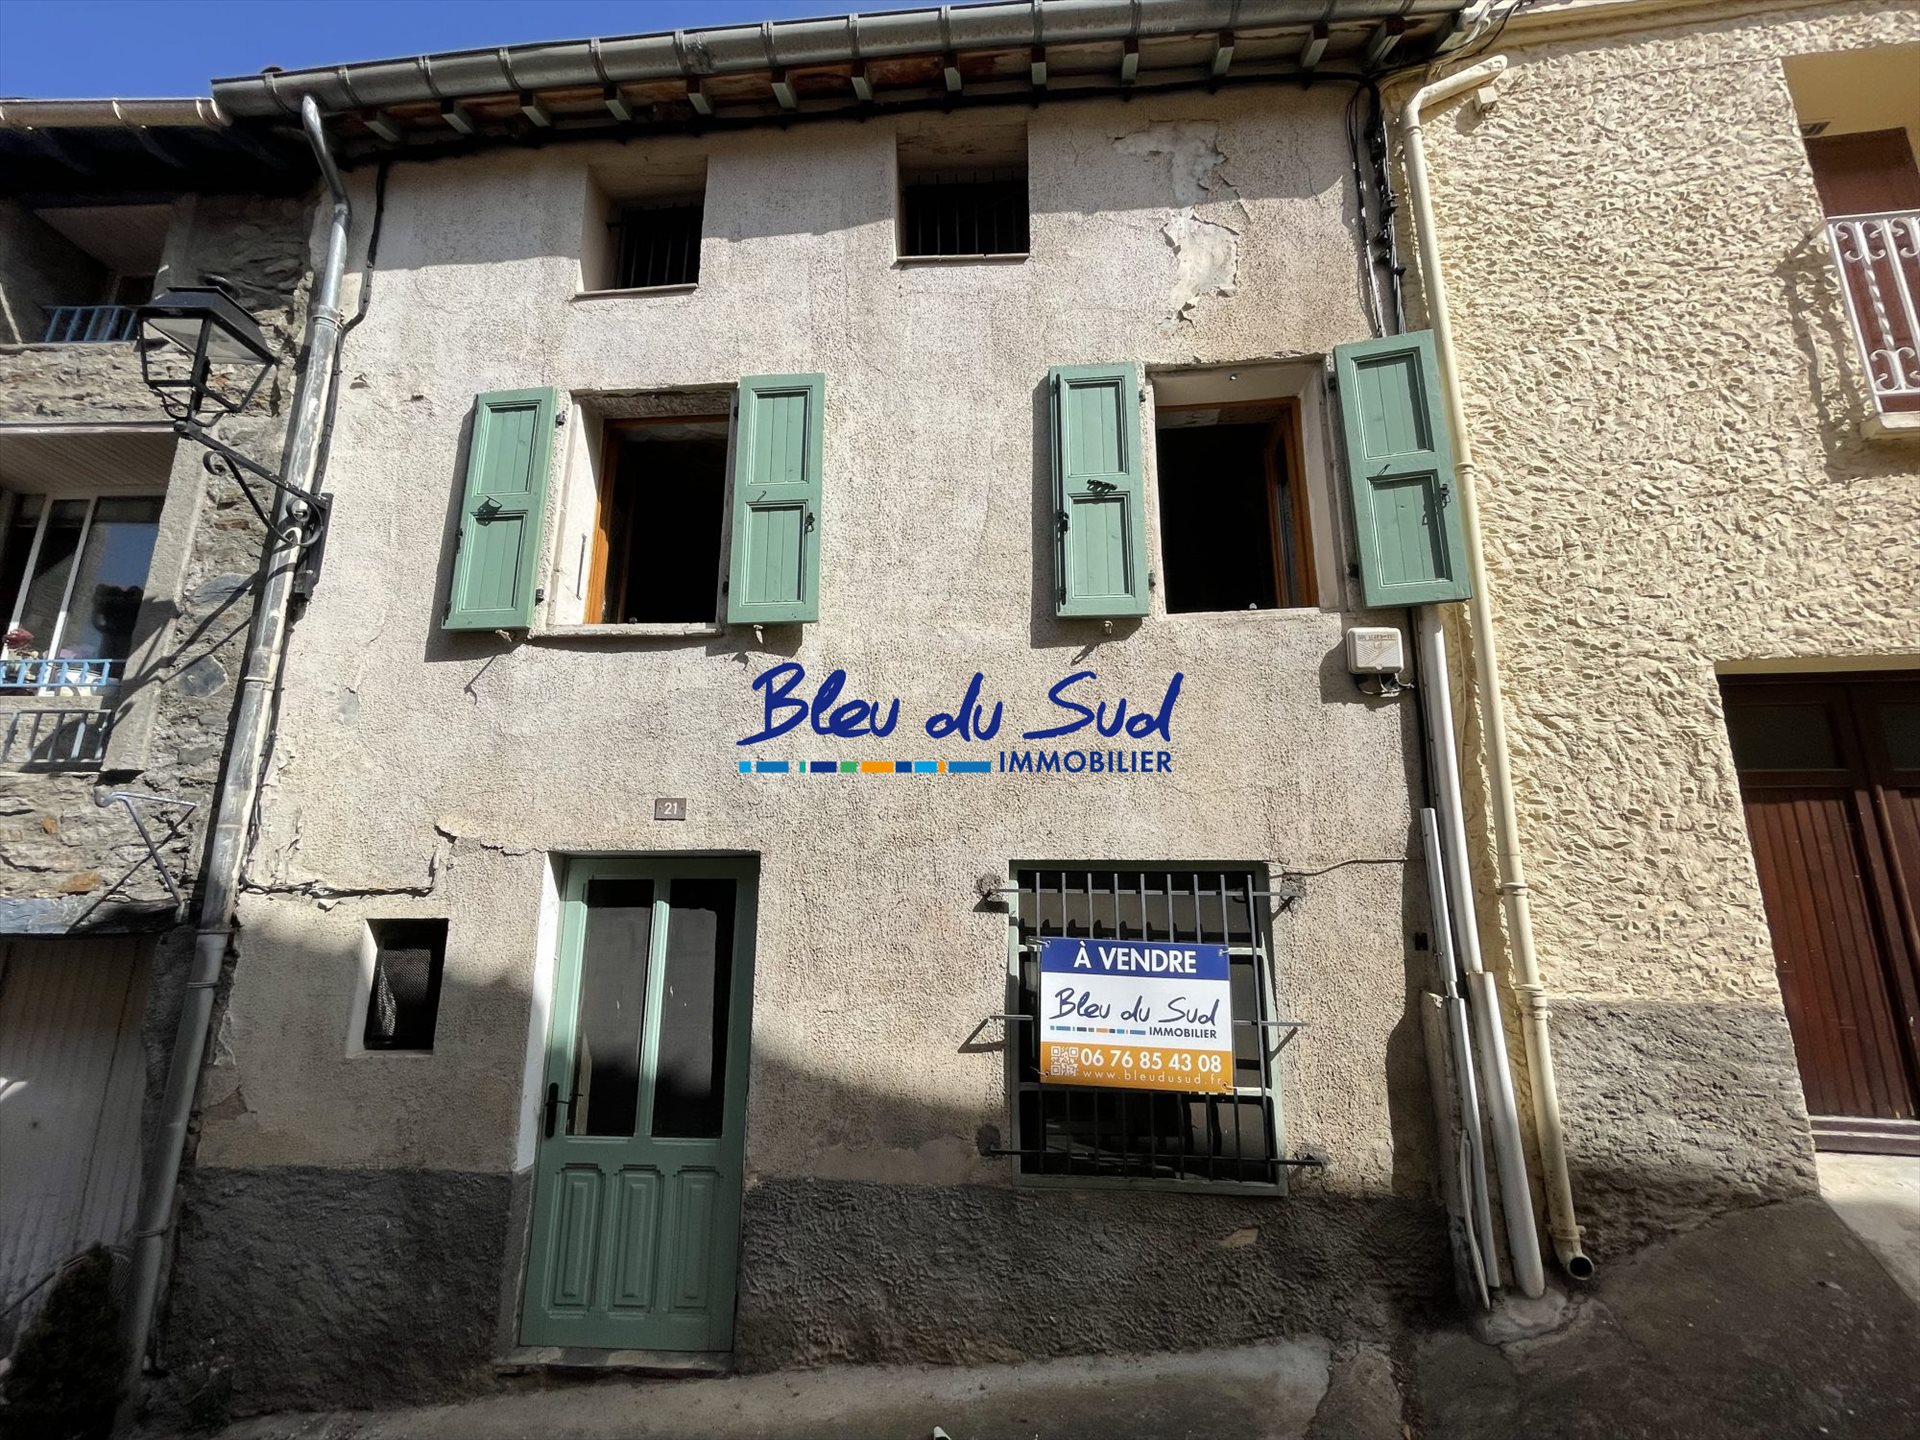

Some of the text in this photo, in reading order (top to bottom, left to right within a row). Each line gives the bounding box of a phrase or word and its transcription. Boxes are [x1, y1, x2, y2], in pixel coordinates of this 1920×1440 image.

[664, 802, 678, 815] 21
[1073, 940, 1197, 974] À VENDRE
[1049, 987, 1220, 1026] Bleu du Sud
[1149, 1026, 1217, 1039] IMMOBILIER
[1080, 1049, 1221, 1073] 06 76 85 43 08
[1083, 1070, 1222, 1085] www.bleudusud.fr
